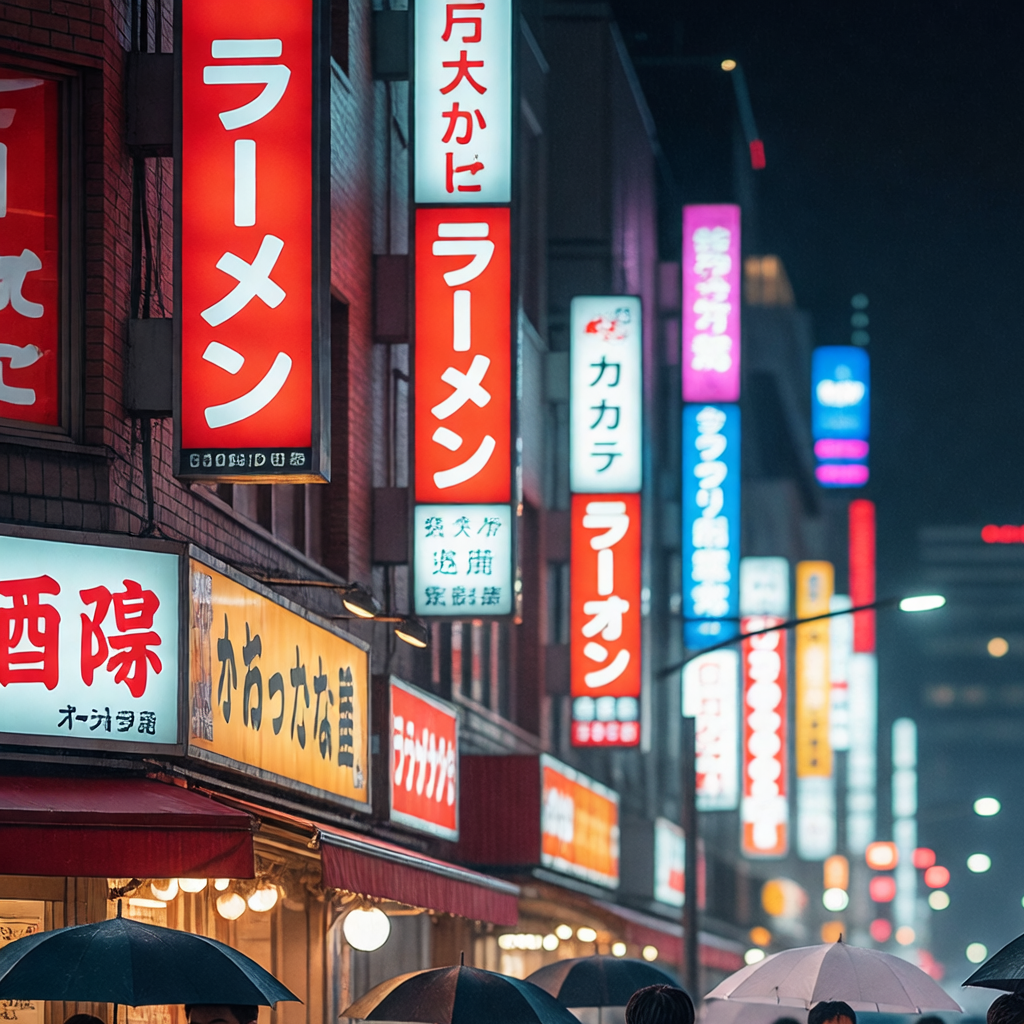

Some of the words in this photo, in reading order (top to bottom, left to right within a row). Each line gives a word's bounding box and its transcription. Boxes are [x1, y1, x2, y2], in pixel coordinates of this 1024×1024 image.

[201, 38, 292, 429] ラーメン
[431, 222, 496, 489] ラーメン
[589, 355, 623, 472] カカテ
[581, 501, 631, 688] ラーオン
